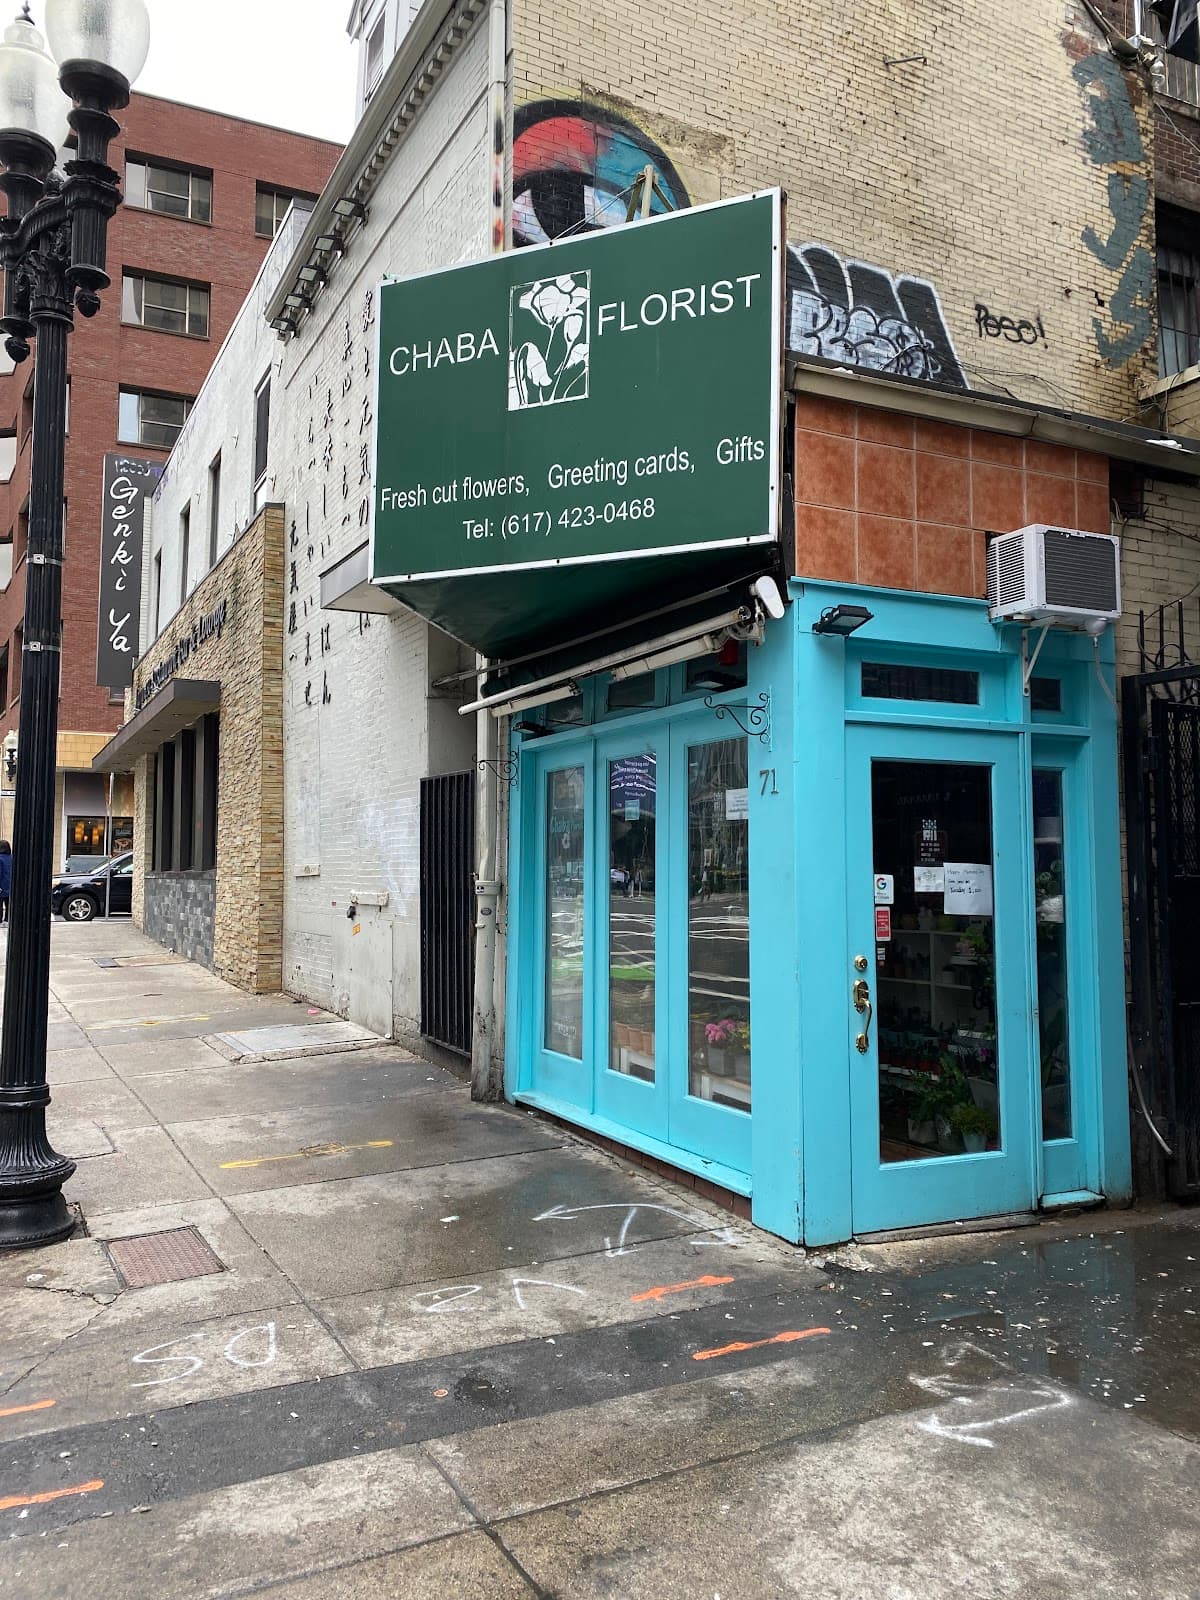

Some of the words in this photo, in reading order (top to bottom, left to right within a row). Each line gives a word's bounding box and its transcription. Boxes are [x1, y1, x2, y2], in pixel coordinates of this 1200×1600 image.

[389, 328, 500, 375] CHABA
[597, 273, 761, 336] FLORIST
[381, 483, 427, 511] Fresh
[432, 480, 458, 503] cut
[463, 474, 531, 501] flowers,
[548, 457, 628, 489] Greeting
[634, 446, 695, 476] cards,
[716, 436, 765, 465] Gifts
[109, 476, 138, 591] Genki
[463, 518, 495, 540] Tel:
[501, 511, 552, 540] (617)
[558, 497, 655, 529] 423-0468
[109, 607, 131, 652] Ya
[759, 768, 779, 796] 71
